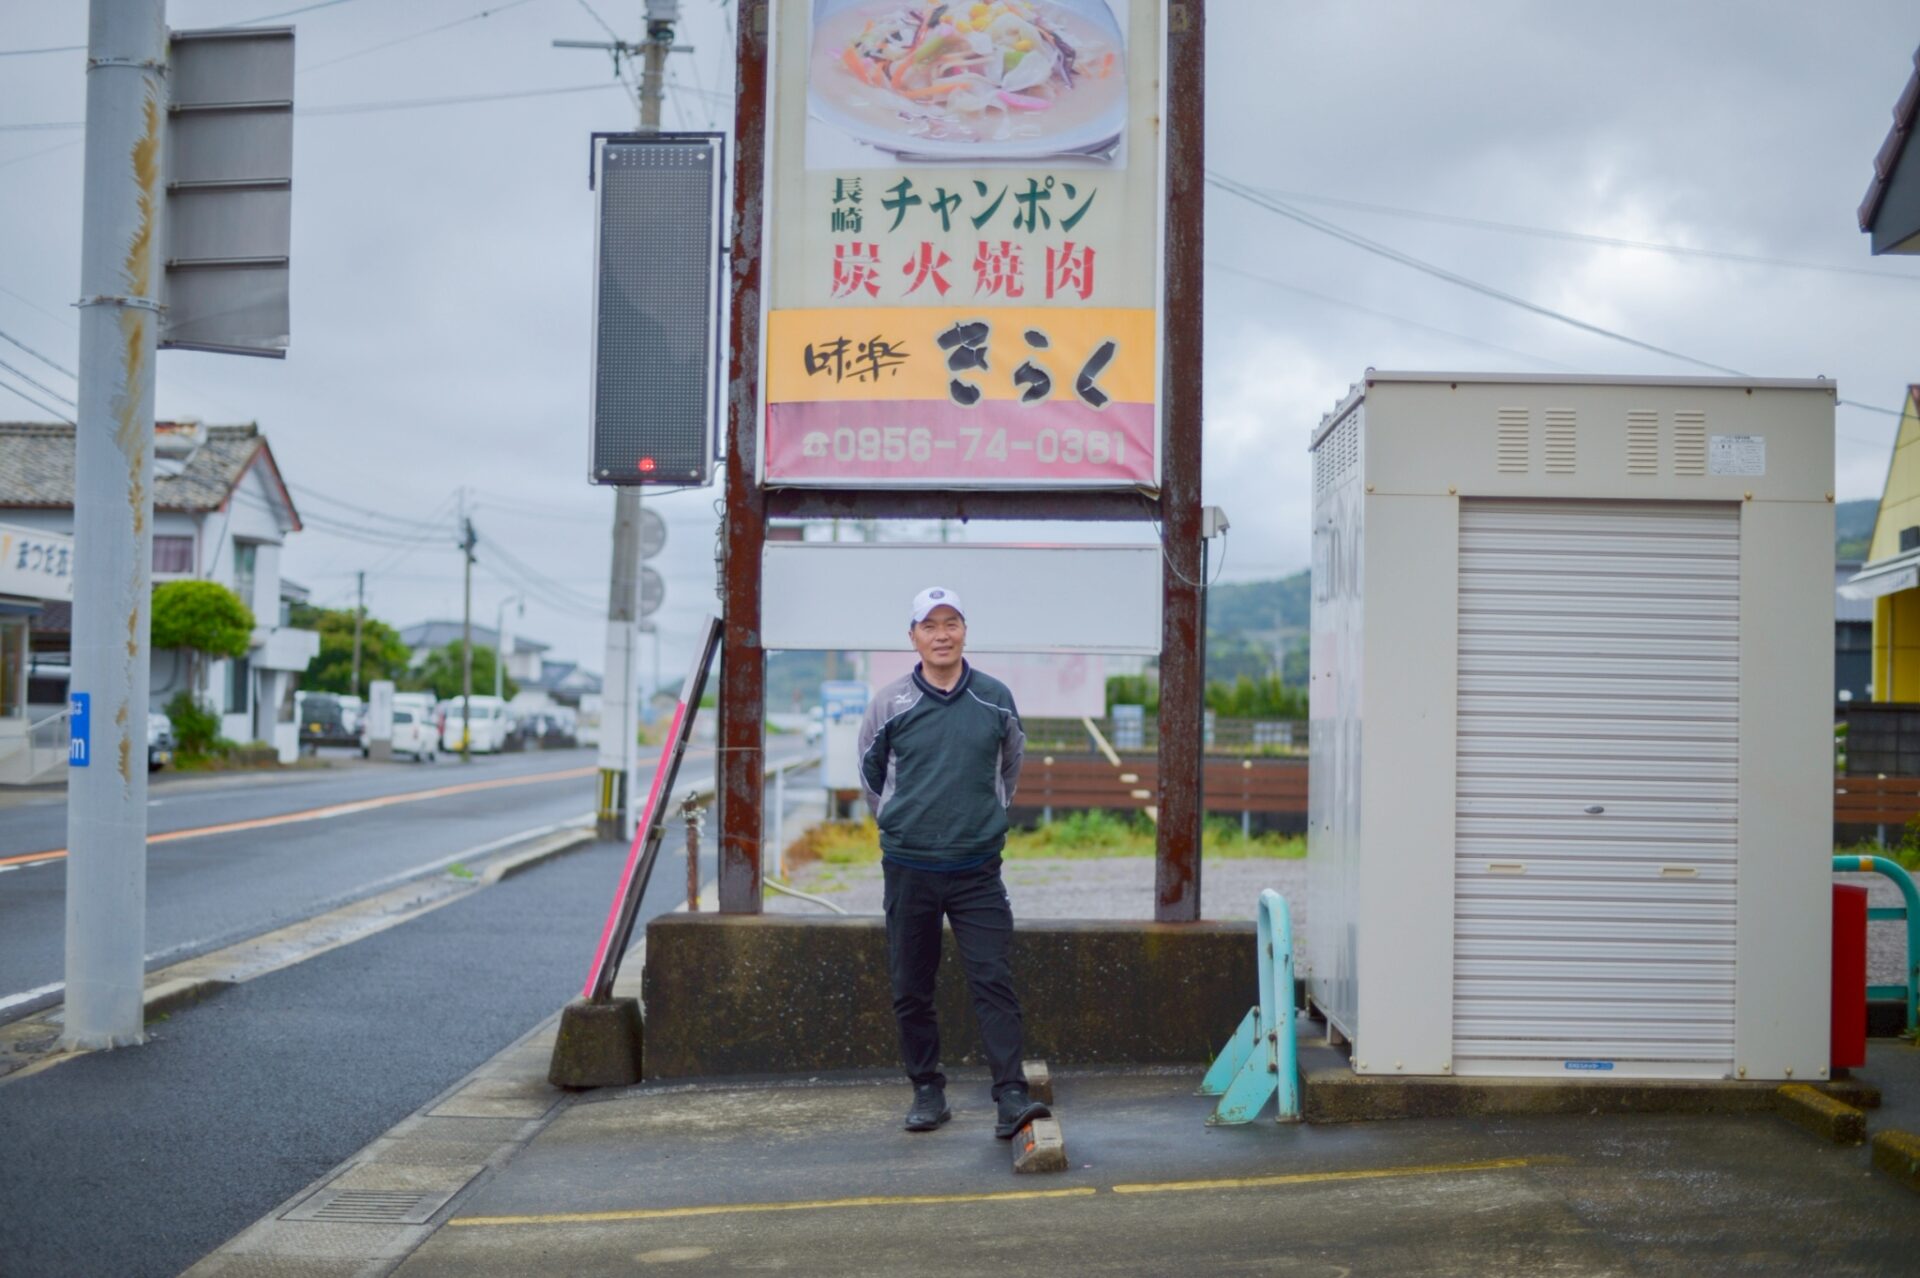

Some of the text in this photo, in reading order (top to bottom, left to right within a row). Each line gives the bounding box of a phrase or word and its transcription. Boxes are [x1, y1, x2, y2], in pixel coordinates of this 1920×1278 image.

[831, 175, 1098, 233] 長崎 チャンポン
[830, 240, 1097, 300] 炭火焼肉
[803, 334, 911, 384] 味楽
